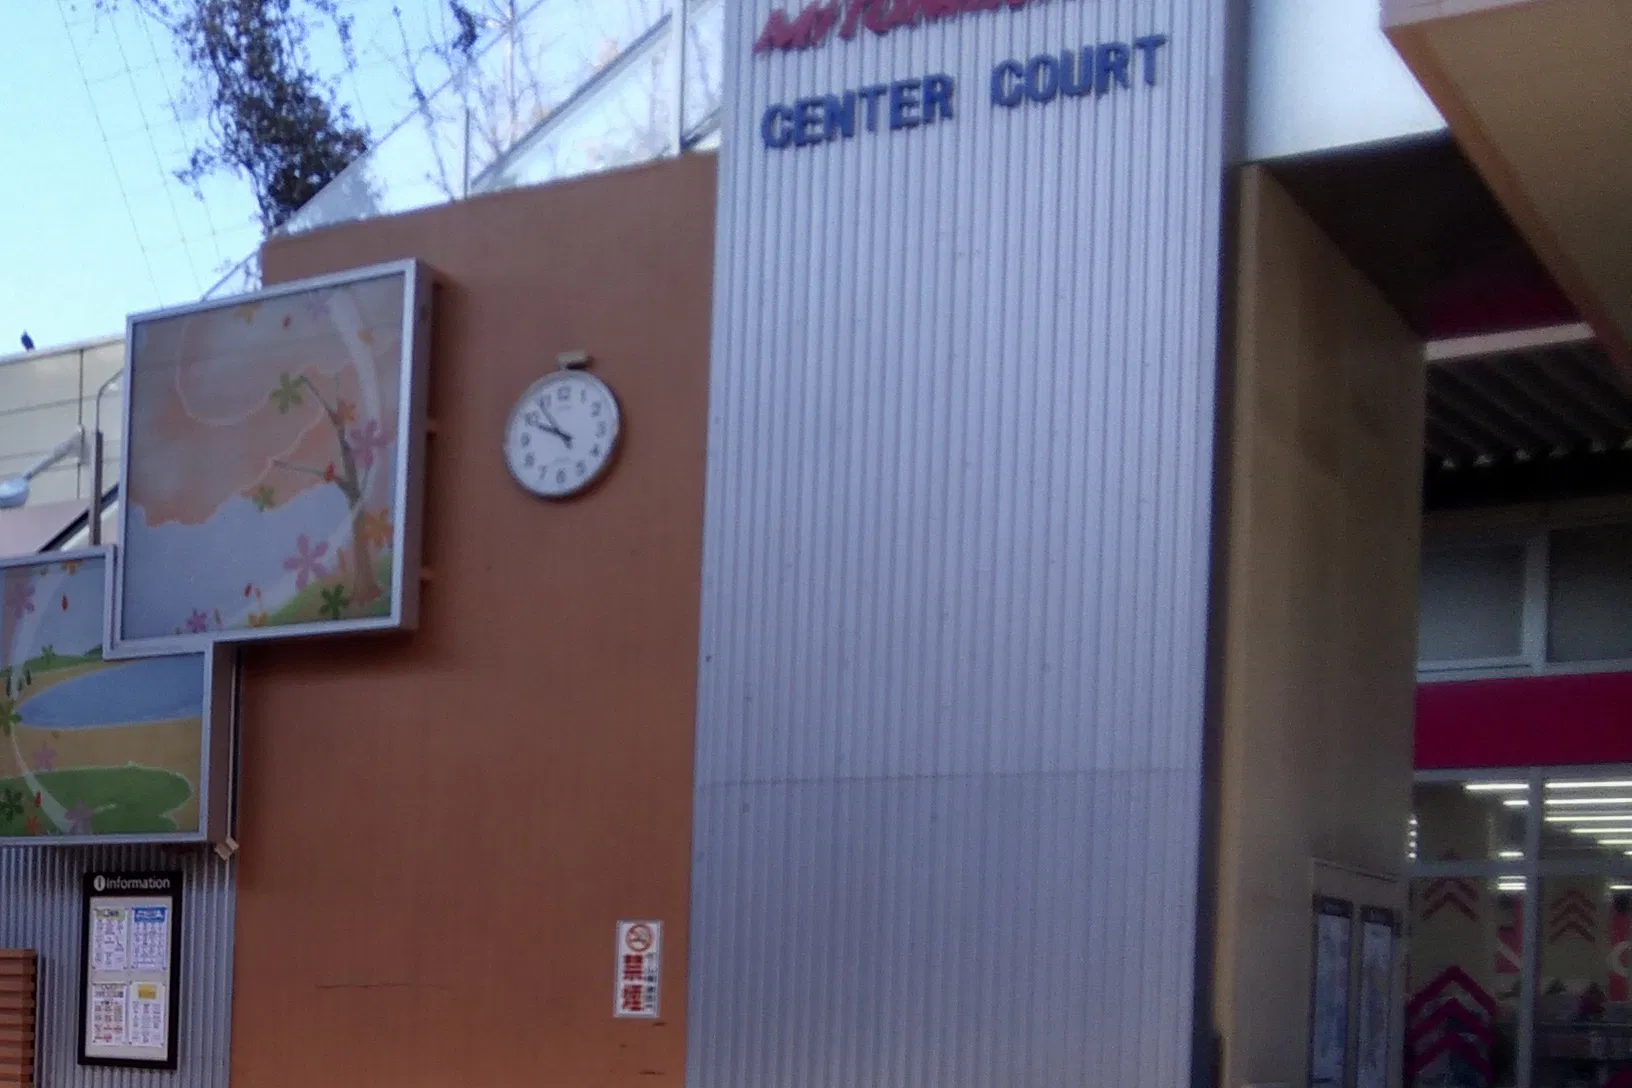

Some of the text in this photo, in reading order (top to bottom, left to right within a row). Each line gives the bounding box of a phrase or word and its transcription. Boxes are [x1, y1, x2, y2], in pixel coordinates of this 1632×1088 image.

[760, 33, 1168, 150] CENTER COURT
[106, 875, 171, 889] Information
